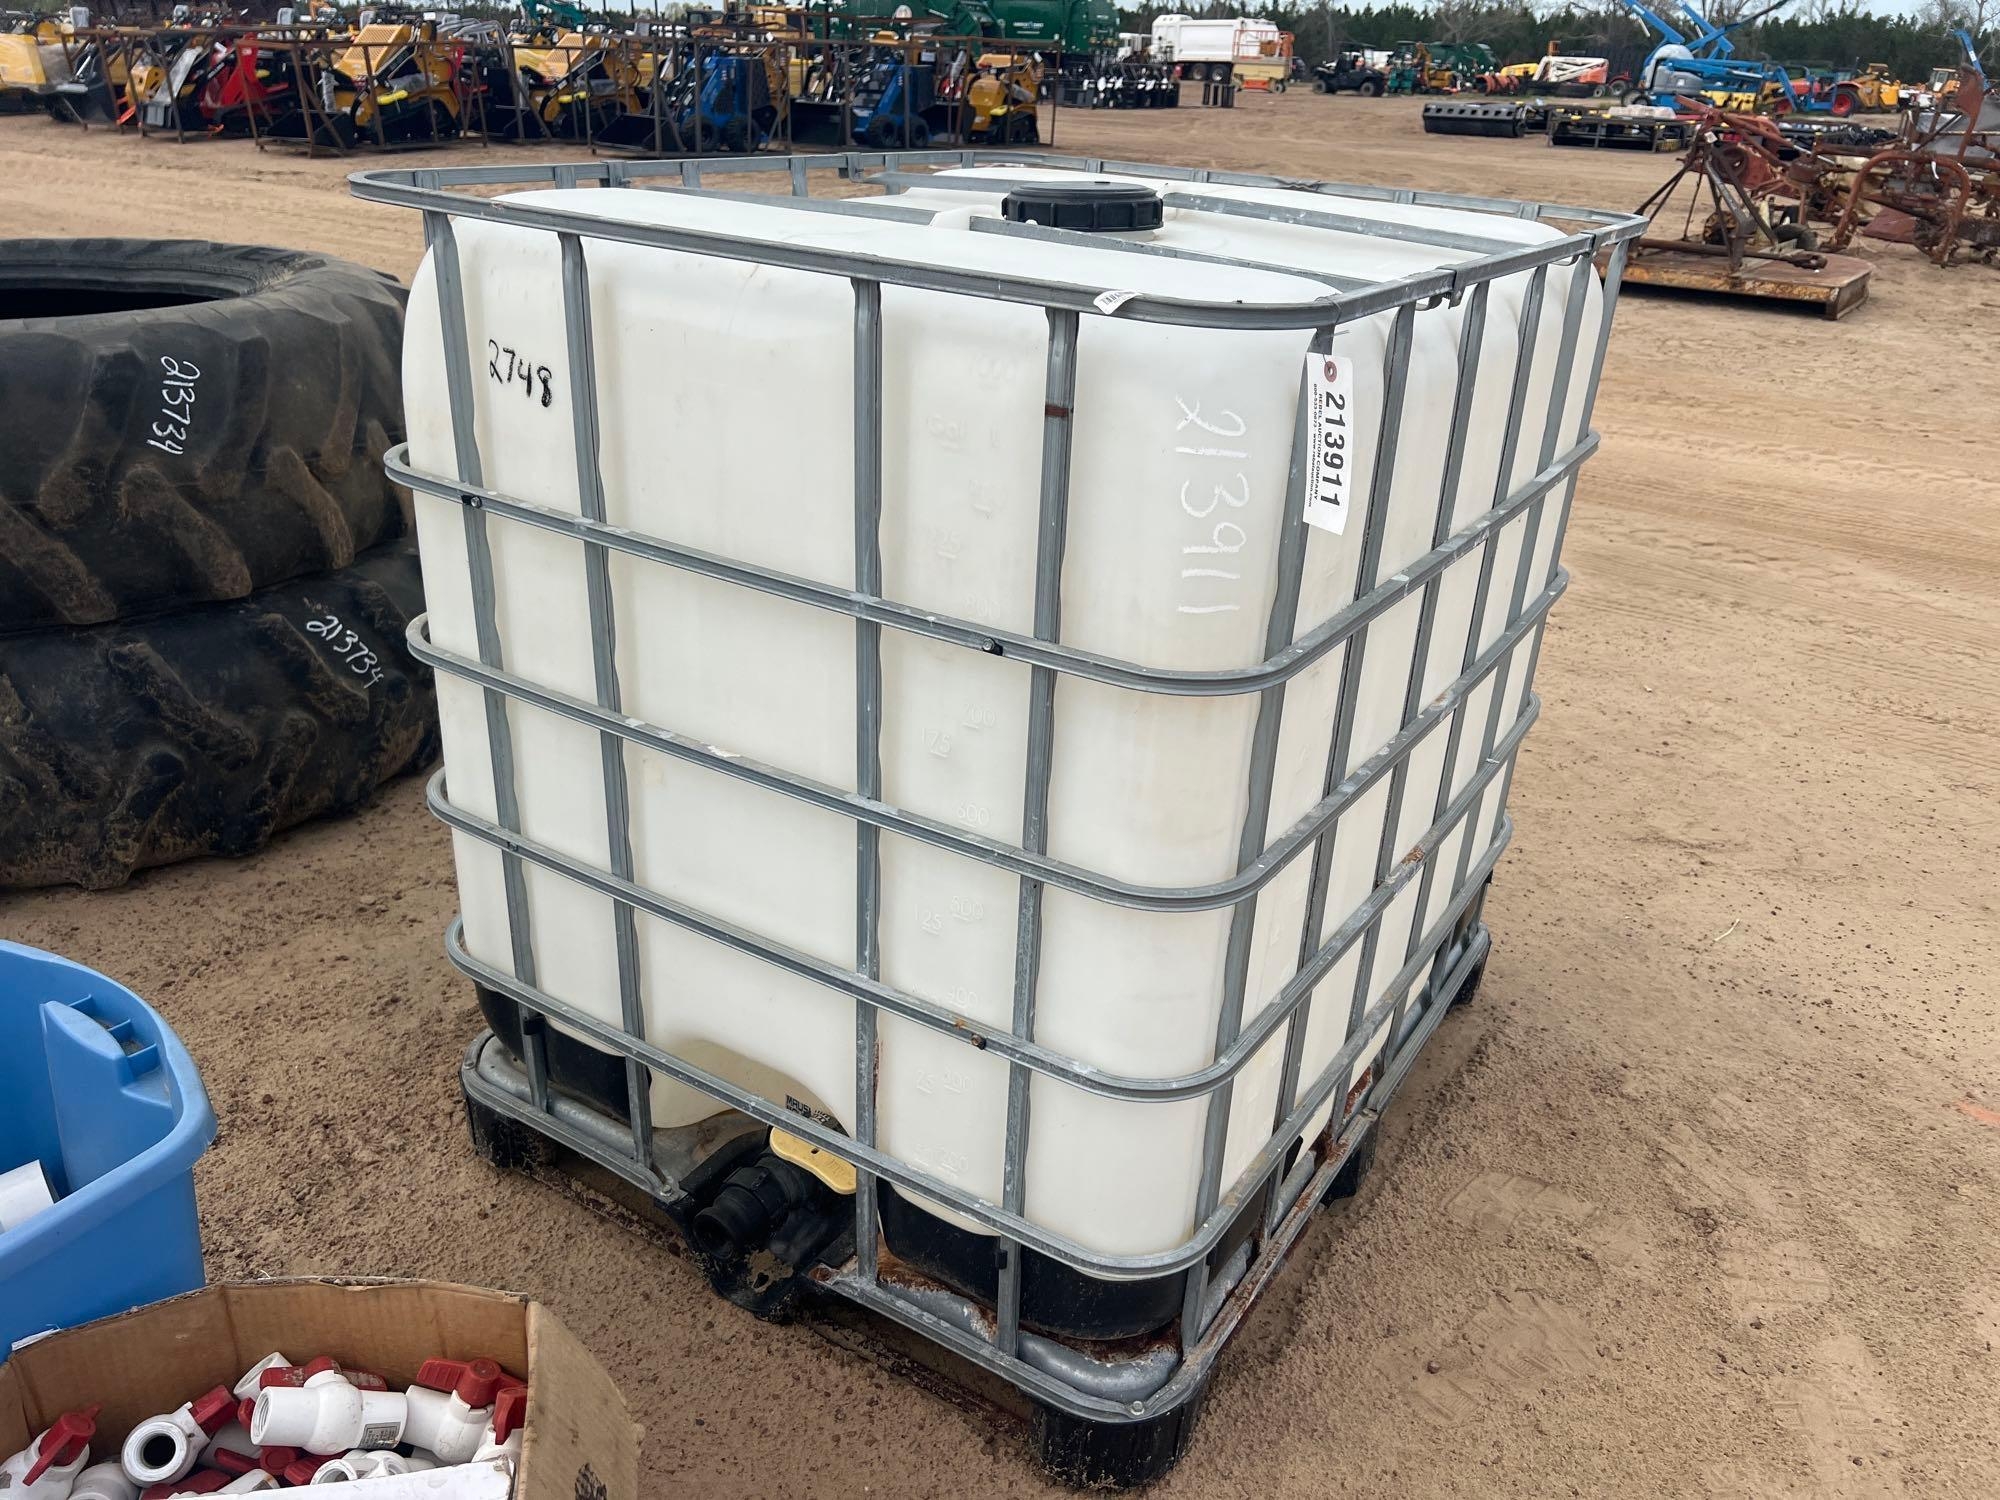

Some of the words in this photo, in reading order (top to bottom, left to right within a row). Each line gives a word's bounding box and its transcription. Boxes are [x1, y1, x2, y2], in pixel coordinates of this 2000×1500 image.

[146, 354, 201, 456] 213734
[488, 338, 553, 408] 2748
[1313, 460, 1321, 500] COMPANY
[1320, 391, 1346, 506] 213911
[1175, 394, 1251, 615] 213911
[305, 614, 385, 689] 213734
[956, 801, 991, 827] 600
[914, 903, 943, 930] 125
